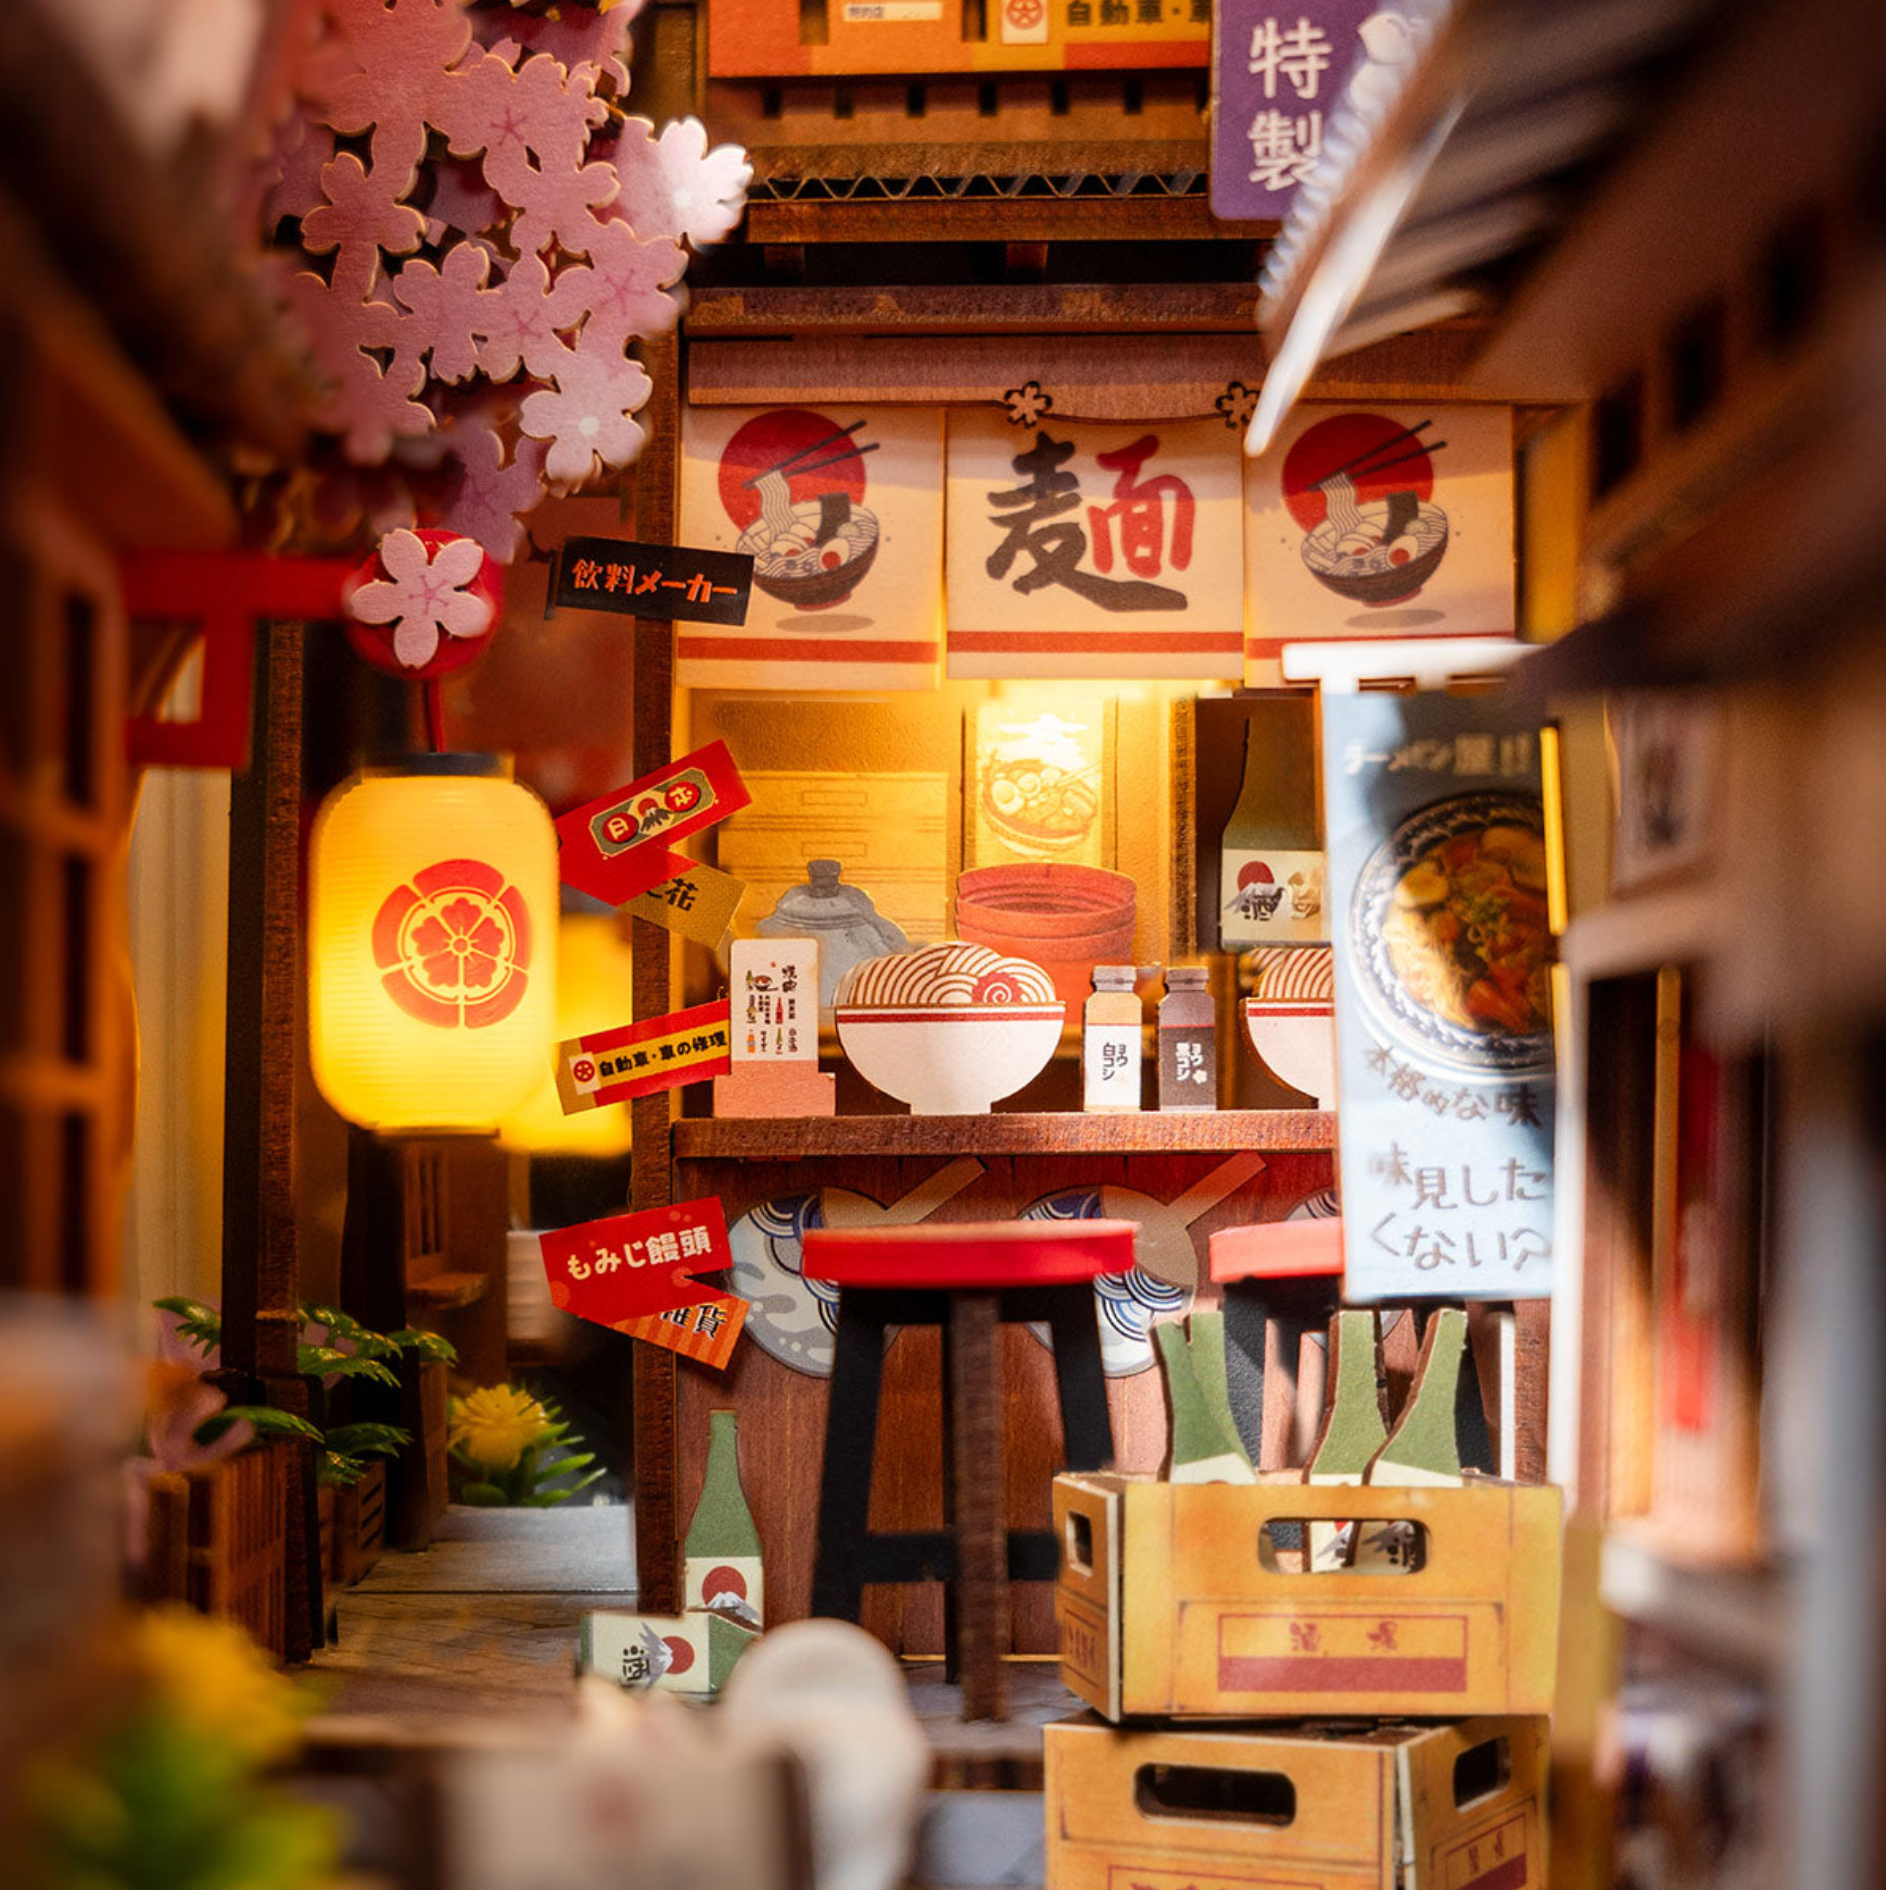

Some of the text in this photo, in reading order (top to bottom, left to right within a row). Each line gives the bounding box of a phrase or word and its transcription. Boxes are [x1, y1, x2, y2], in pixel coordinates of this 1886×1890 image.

[1247, 16, 1334, 192] 特製
[571, 558, 738, 603] 飲料メーカー
[1367, 1141, 1547, 1210] 味見した
[567, 1226, 713, 1281] もみじ饅頭
